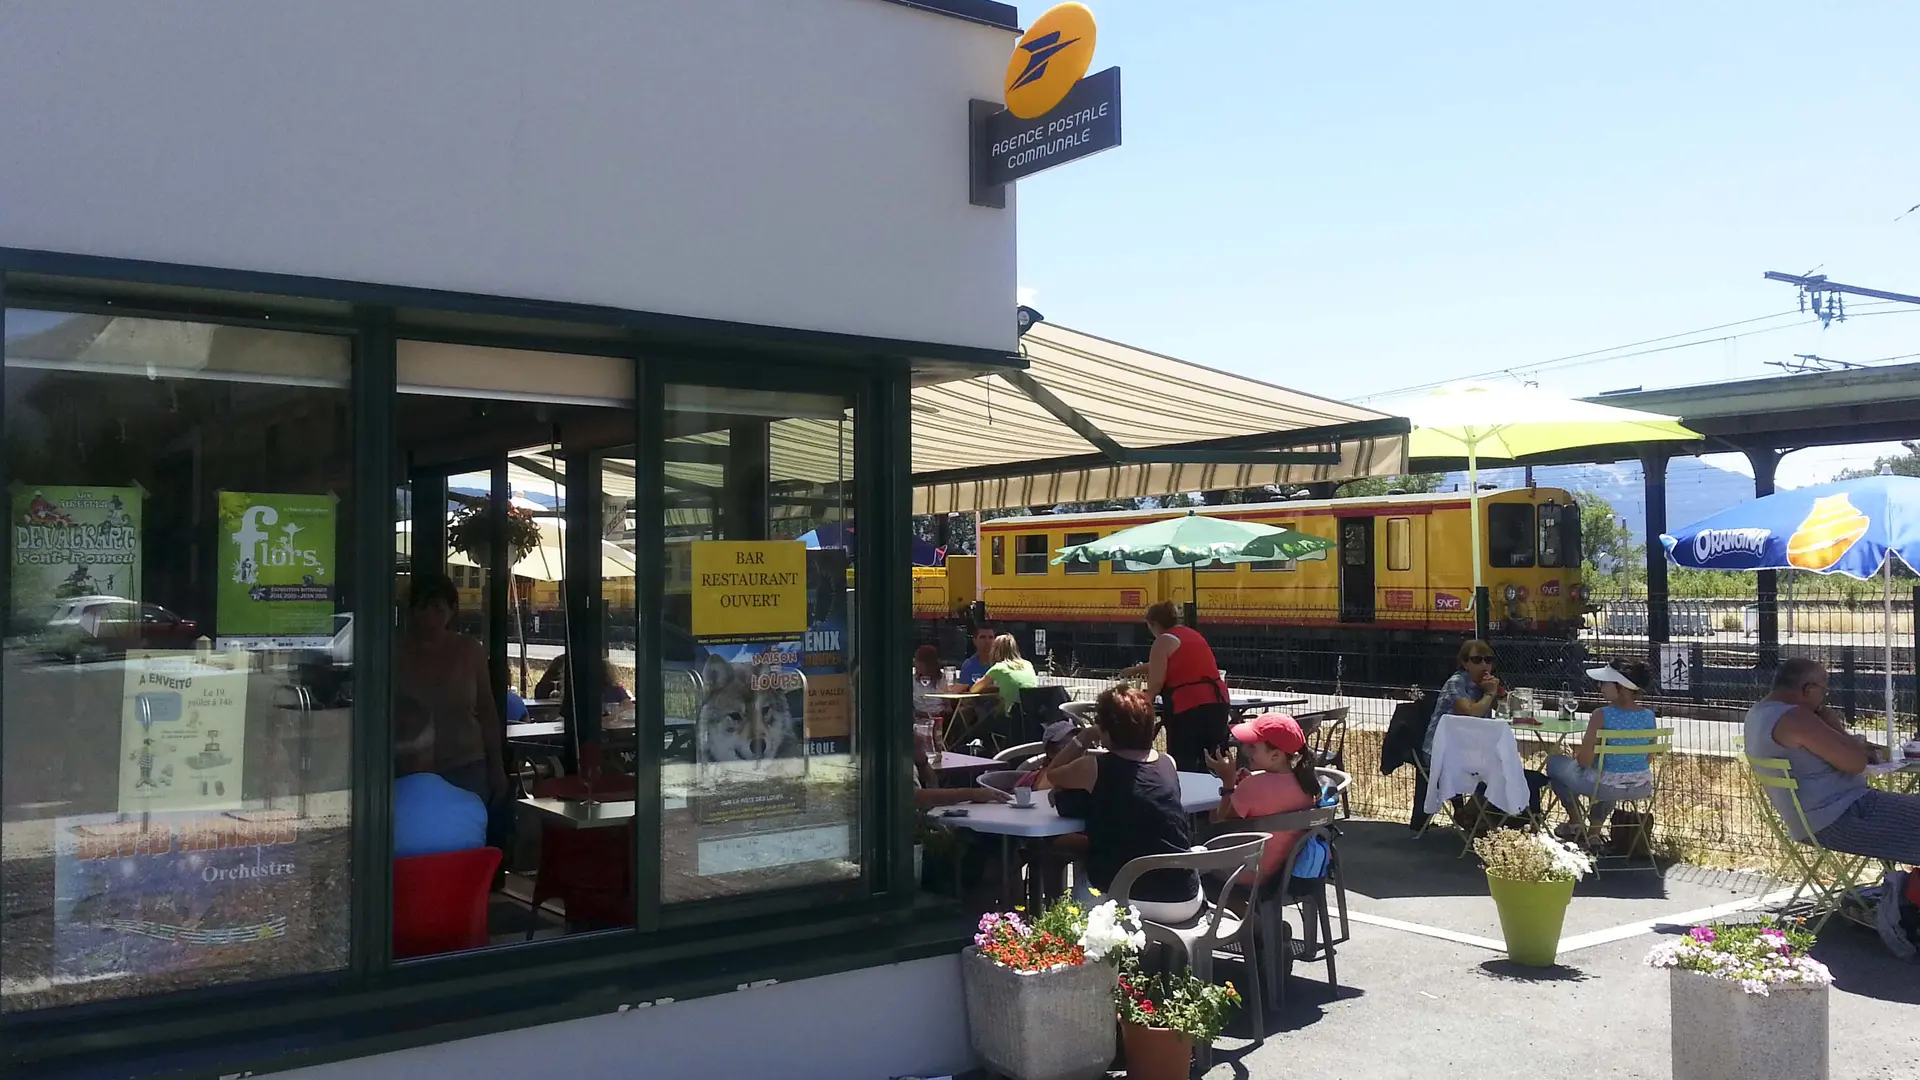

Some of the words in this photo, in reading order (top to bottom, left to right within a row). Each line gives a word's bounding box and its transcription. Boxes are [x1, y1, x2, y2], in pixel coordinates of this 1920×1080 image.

[992, 126, 1043, 157] AGENCE
[1048, 101, 1109, 136] POSTALE
[1007, 128, 1091, 169] COMMUNALE
[16, 525, 136, 550] DEVALKART
[231, 505, 319, 583] flors
[1695, 529, 1770, 563] ORANGINA
[736, 551, 765, 565] BAR
[701, 572, 798, 587] RESTAURANT
[1541, 585, 1559, 595] SNCF
[720, 594, 780, 608] OUVERT
[1436, 598, 1460, 608] SNCF
[751, 652, 798, 667] MAISON
[149, 673, 192, 690] ENVEITG
[750, 672, 800, 691] LOUPS
[201, 862, 296, 882] Orchestre
